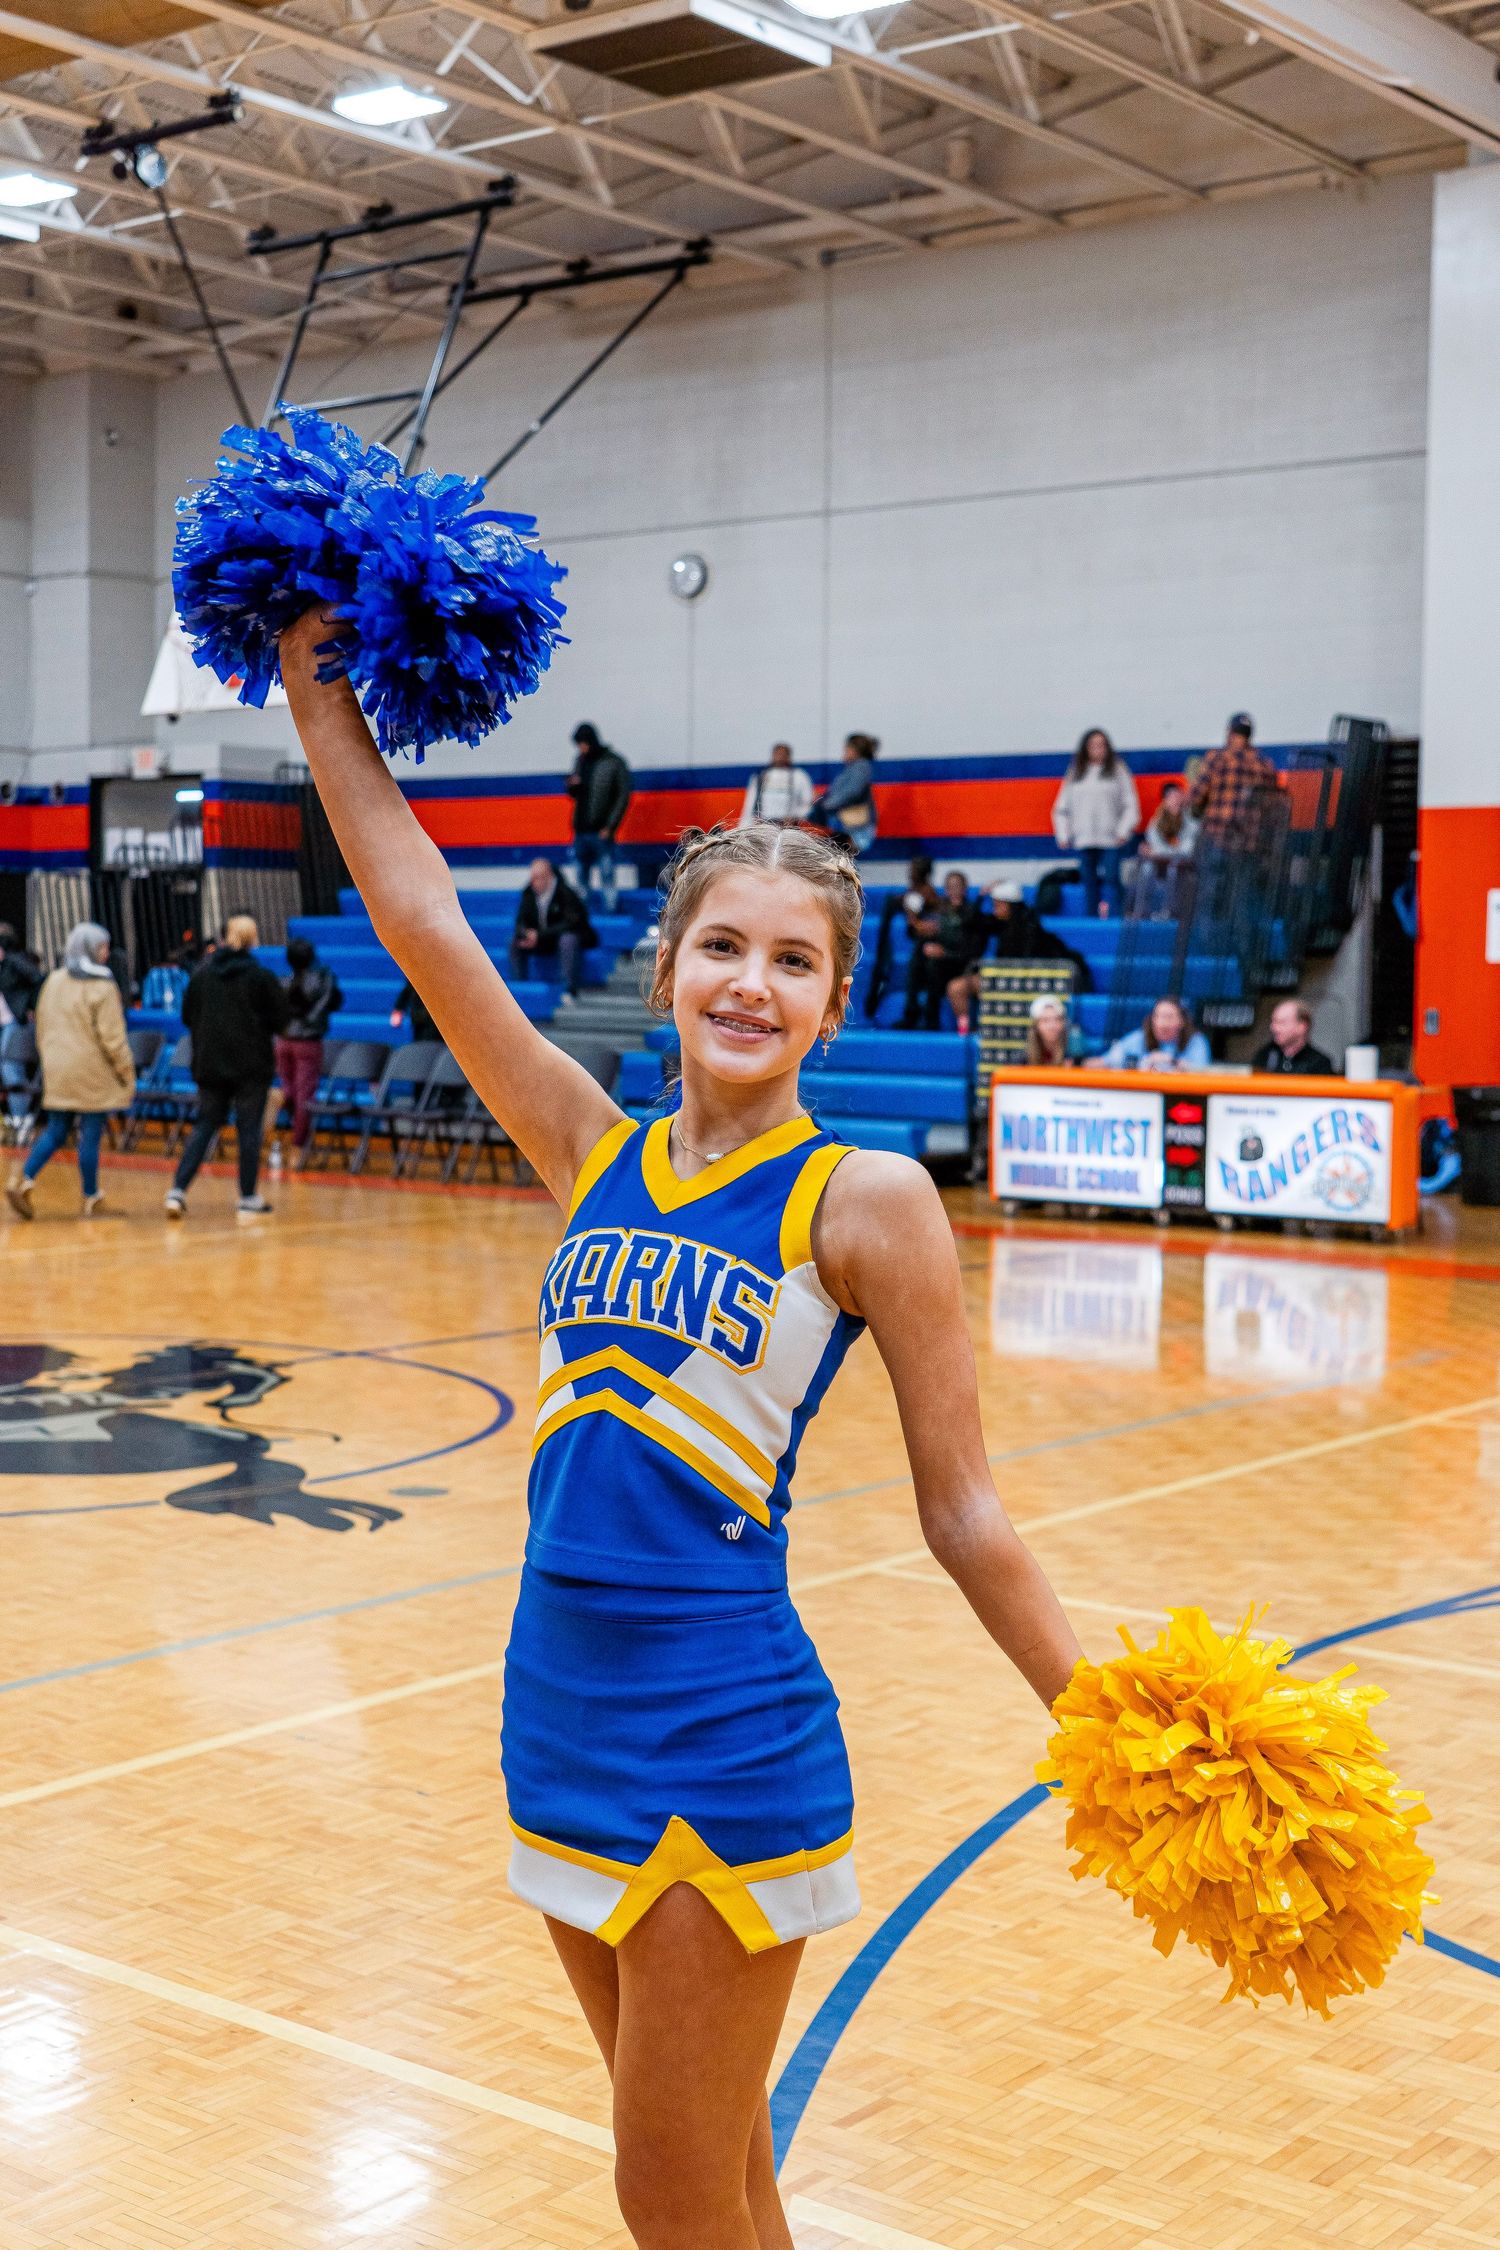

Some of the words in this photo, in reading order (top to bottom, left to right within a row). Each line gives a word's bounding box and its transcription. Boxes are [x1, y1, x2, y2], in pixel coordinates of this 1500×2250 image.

[1001, 1114, 1152, 1157] NORTHWEST
[1218, 1109, 1380, 1201] RANGERS
[540, 1227, 783, 1376] KARNS
